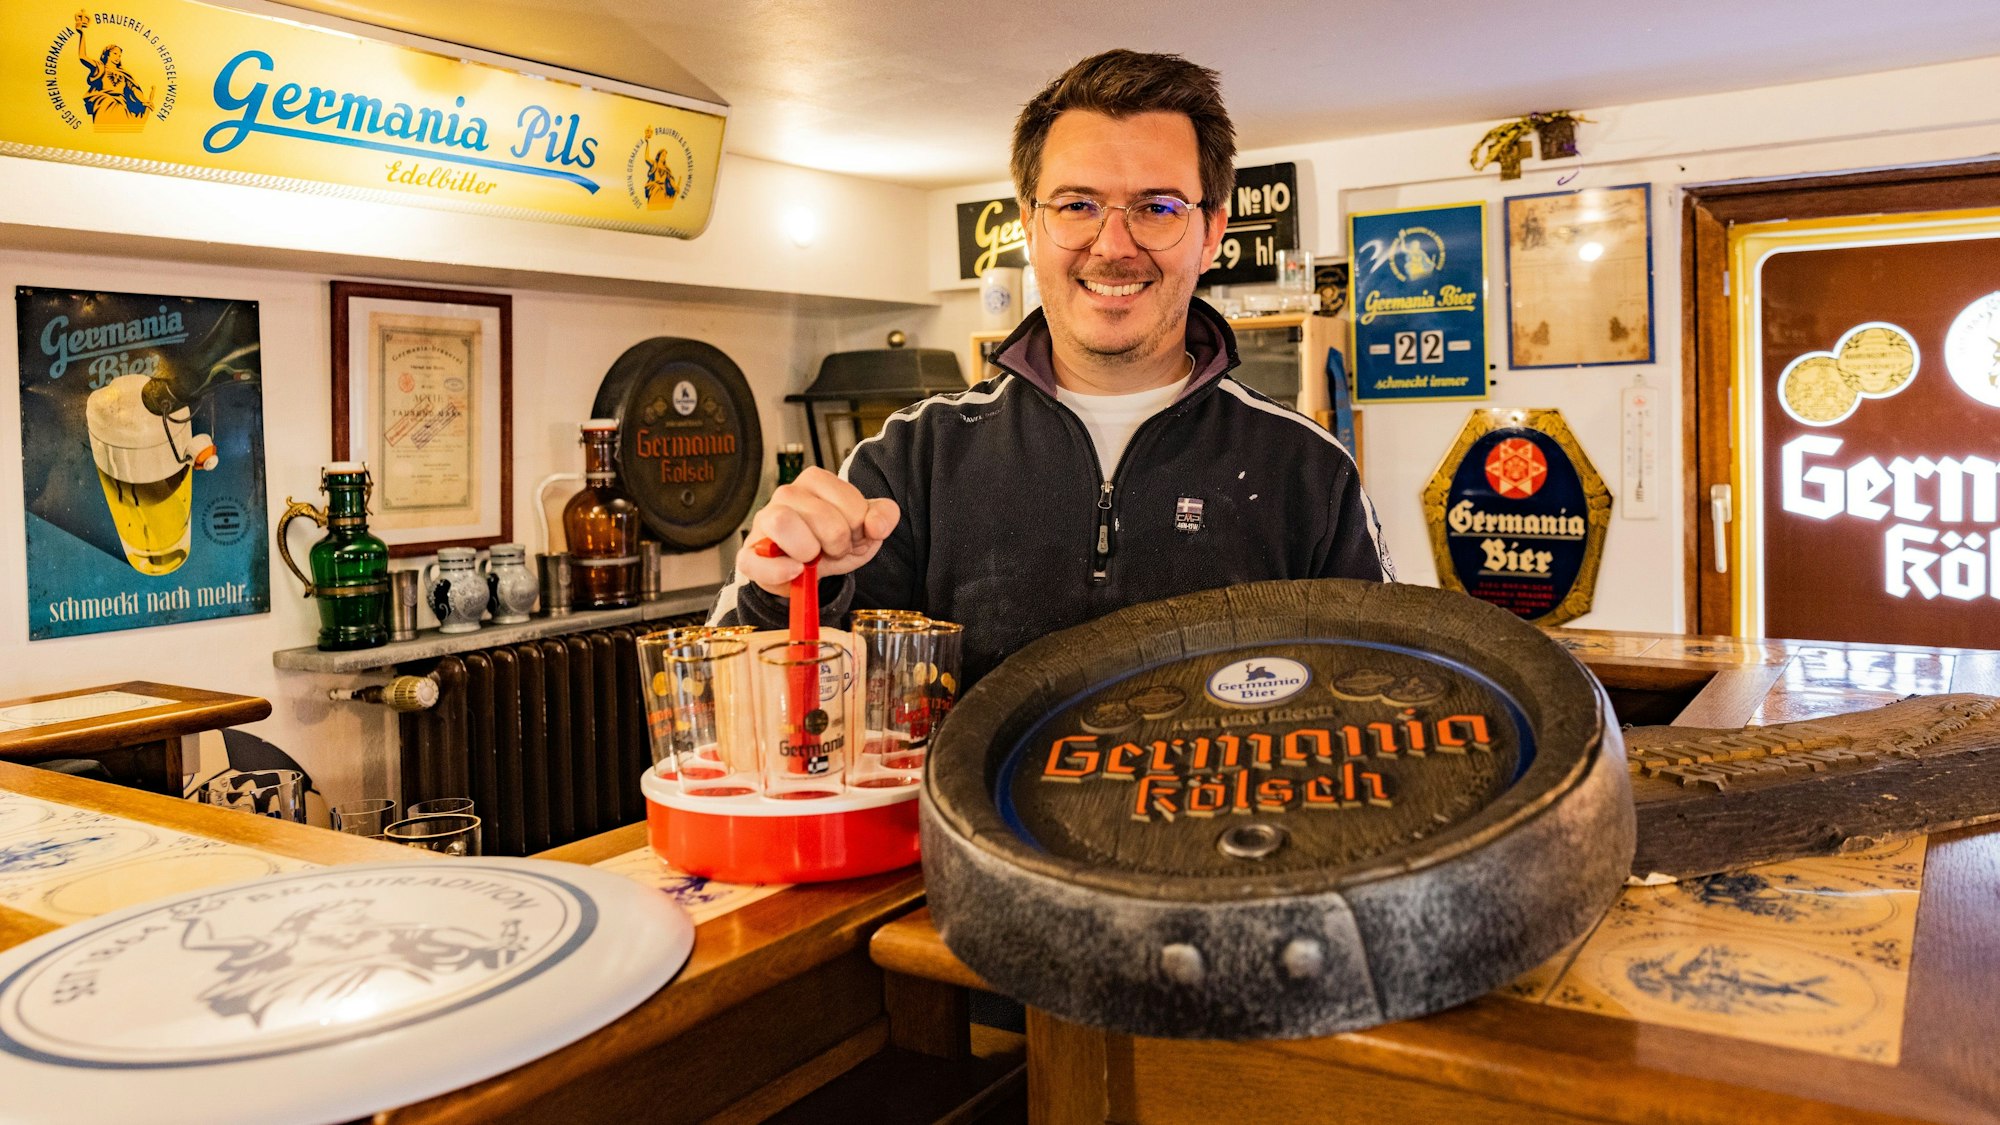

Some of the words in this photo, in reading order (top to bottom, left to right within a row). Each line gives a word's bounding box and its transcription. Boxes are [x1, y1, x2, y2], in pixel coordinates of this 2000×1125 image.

[45, 26, 75, 75] GERMANIA
[94, 13, 144, 34] BRAUEREI
[203, 50, 489, 154] Germania
[510, 104, 599, 169] Pils
[385, 160, 498, 195] Edelbitter
[1255, 236, 1274, 267] hl
[1361, 289, 1436, 325] Germania
[1437, 284, 1477, 307] Bier
[40, 304, 186, 379] Germania
[1398, 333, 1441, 361] 22
[1374, 375, 1429, 390] schmeckt
[1430, 374, 1469, 388] immer
[637, 428, 736, 459] Germania
[1783, 434, 2000, 522] Germ
[1448, 499, 1586, 536] Germania
[1480, 538, 1554, 573] Bier
[50, 591, 140, 623] schmeckt
[147, 586, 191, 613] nach
[197, 581, 261, 608] mehr...
[1217, 676, 1300, 691] Germania
[1241, 689, 1277, 699] Bier
[1042, 708, 1492, 780] Germania
[246, 875, 540, 911] BRAUTRADITION
